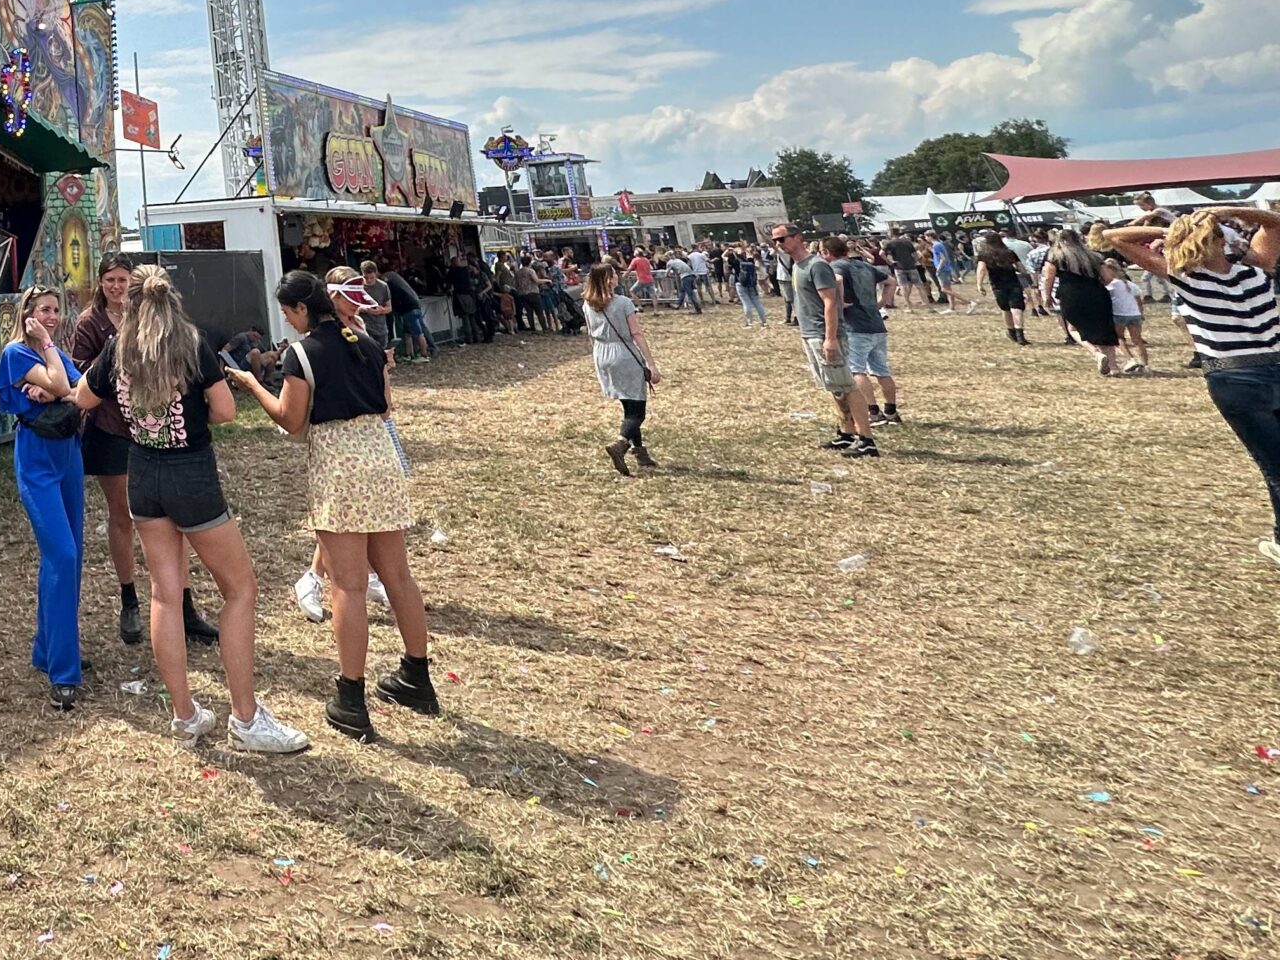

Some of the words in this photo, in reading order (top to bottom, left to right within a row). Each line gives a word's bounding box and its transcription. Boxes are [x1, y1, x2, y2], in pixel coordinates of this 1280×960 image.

[328, 135, 376, 191] GUN
[642, 200, 716, 213] STADSPLEIN
[954, 214, 987, 225] AFVAL
